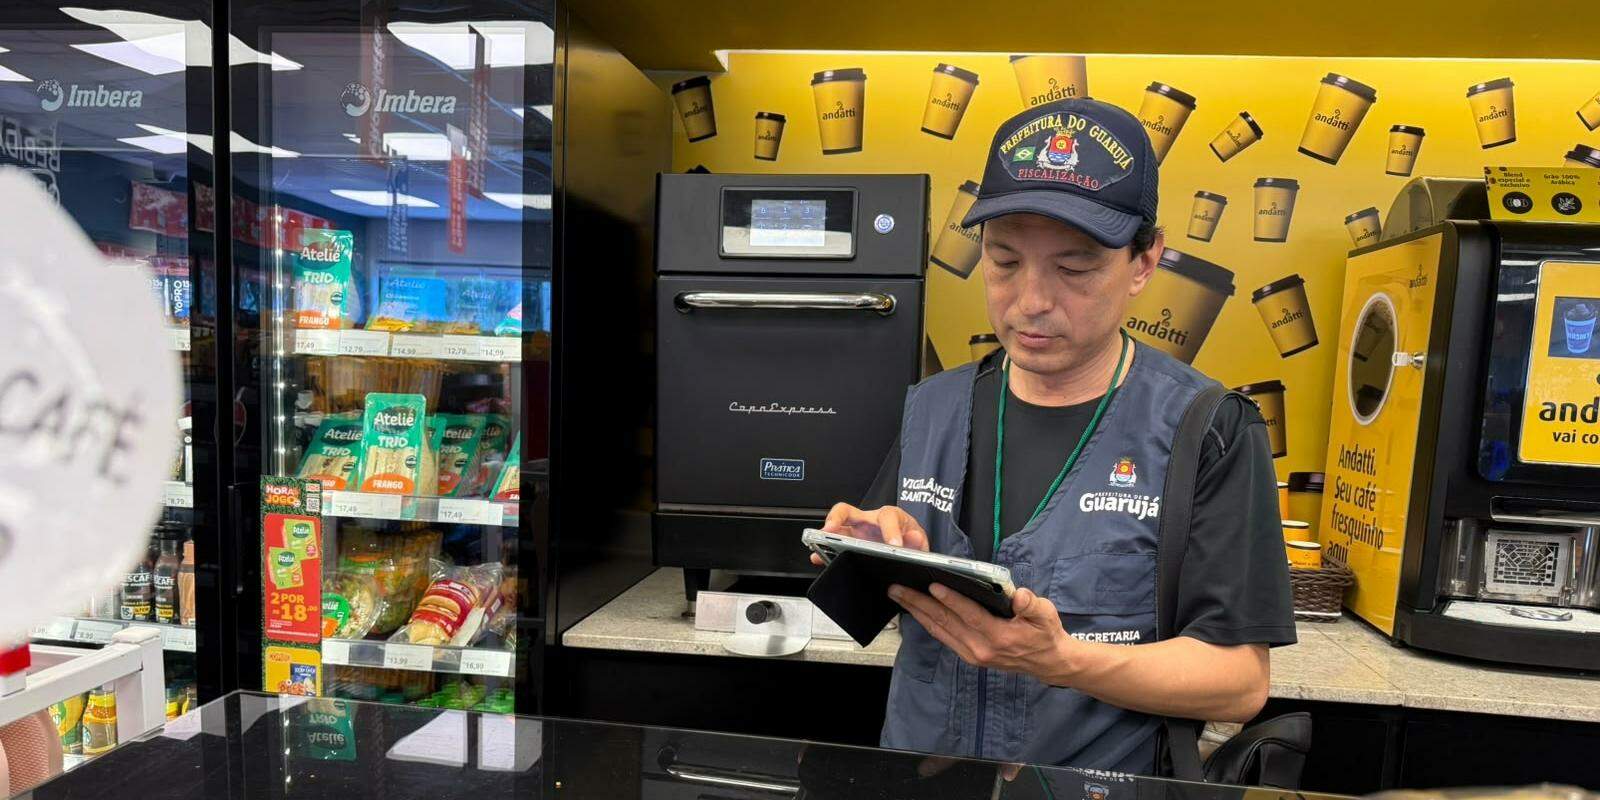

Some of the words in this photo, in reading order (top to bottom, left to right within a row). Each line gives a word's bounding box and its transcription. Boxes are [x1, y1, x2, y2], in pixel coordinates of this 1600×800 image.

[67, 84, 143, 108] Imbera
[374, 89, 456, 114] Imbera
[931, 96, 961, 112] andatti
[1031, 84, 1077, 105] andatti
[822, 107, 856, 120] andatti
[1315, 112, 1350, 131] andatti
[1479, 108, 1508, 122] andatti
[1141, 118, 1171, 136] andatti
[1000, 114, 1062, 154] PREFEITURA
[1067, 114, 1086, 130] DO
[1089, 125, 1135, 170] GUARUJÁ
[1018, 168, 1099, 190] FISCALIZAÇÃO
[1257, 207, 1287, 217] andatti
[303, 270, 335, 284] TRIO
[298, 315, 330, 326] FRANGO
[1271, 310, 1304, 329] andatti
[1126, 315, 1189, 347] andatti
[378, 435, 409, 448] TRIO
[1553, 429, 1577, 443] vai
[322, 445, 352, 456] TRIO
[1338, 443, 1377, 476] Andatti.
[900, 490, 953, 513] SANITÁRIA
[1334, 475, 1351, 503] Seu
[1354, 481, 1377, 512] café
[1079, 493, 1160, 520] Guarujá
[1331, 503, 1384, 551] fresquinho
[270, 592, 281, 605] 2
[280, 592, 305, 604] POR
[280, 602, 308, 622] 18
[1070, 630, 1141, 643] SECRETARIA
